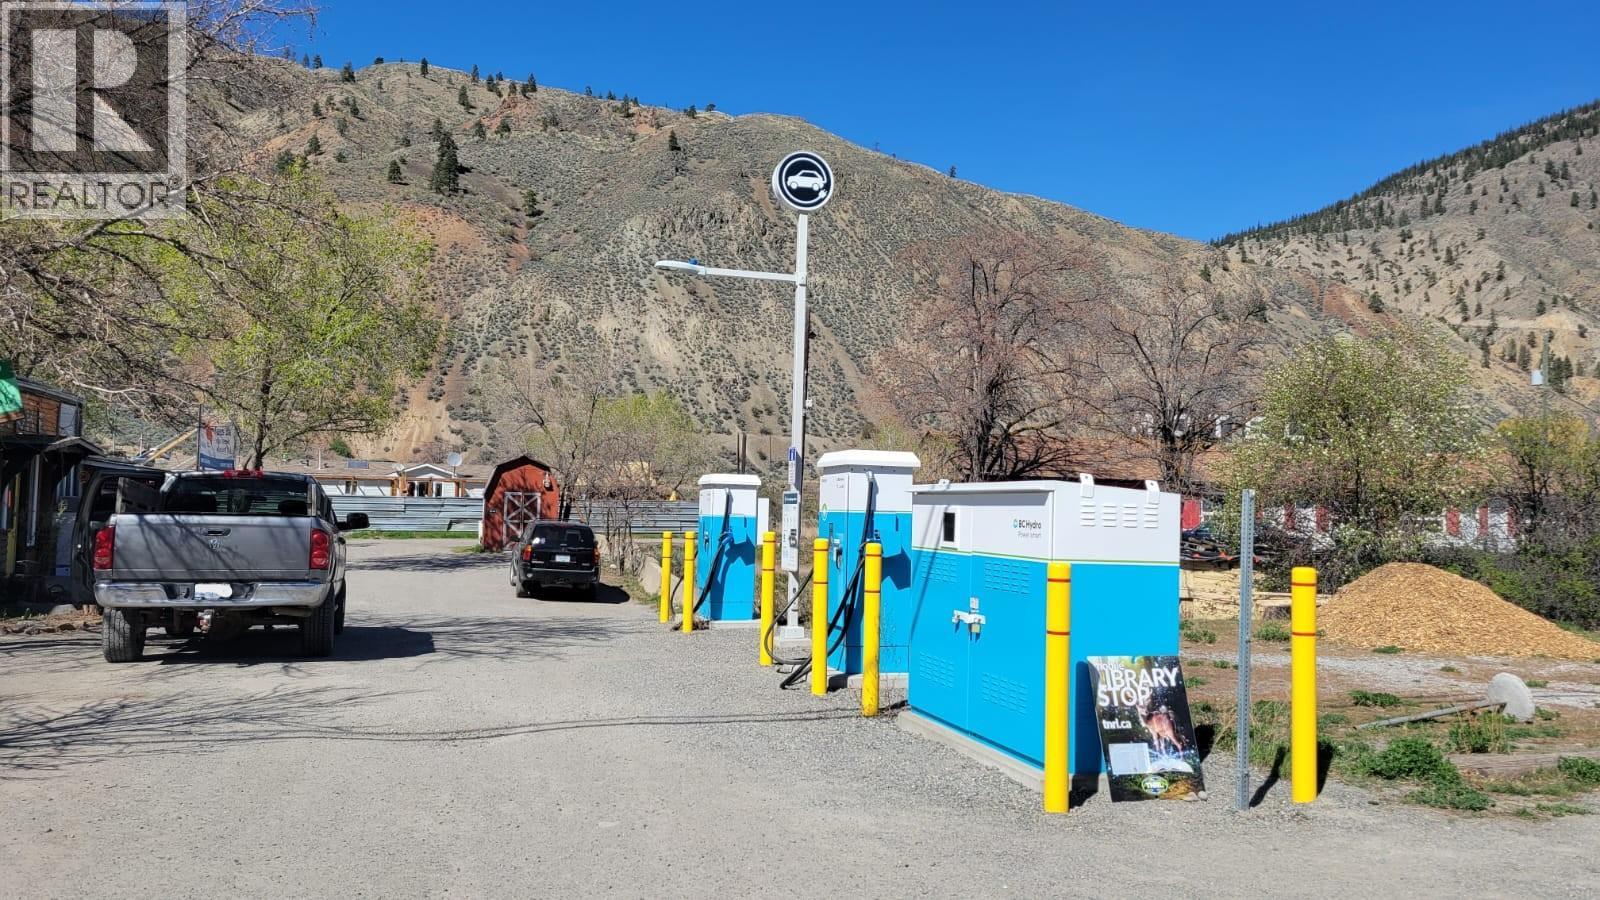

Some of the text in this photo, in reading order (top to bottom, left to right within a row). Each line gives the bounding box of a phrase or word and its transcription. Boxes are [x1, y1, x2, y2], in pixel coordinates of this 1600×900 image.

[1018, 519, 1041, 530] BC Hydro
[1098, 667, 1179, 690] LIBRARY
[1097, 686, 1151, 707] STOP
[1102, 718, 1132, 730] tnrl.ca
